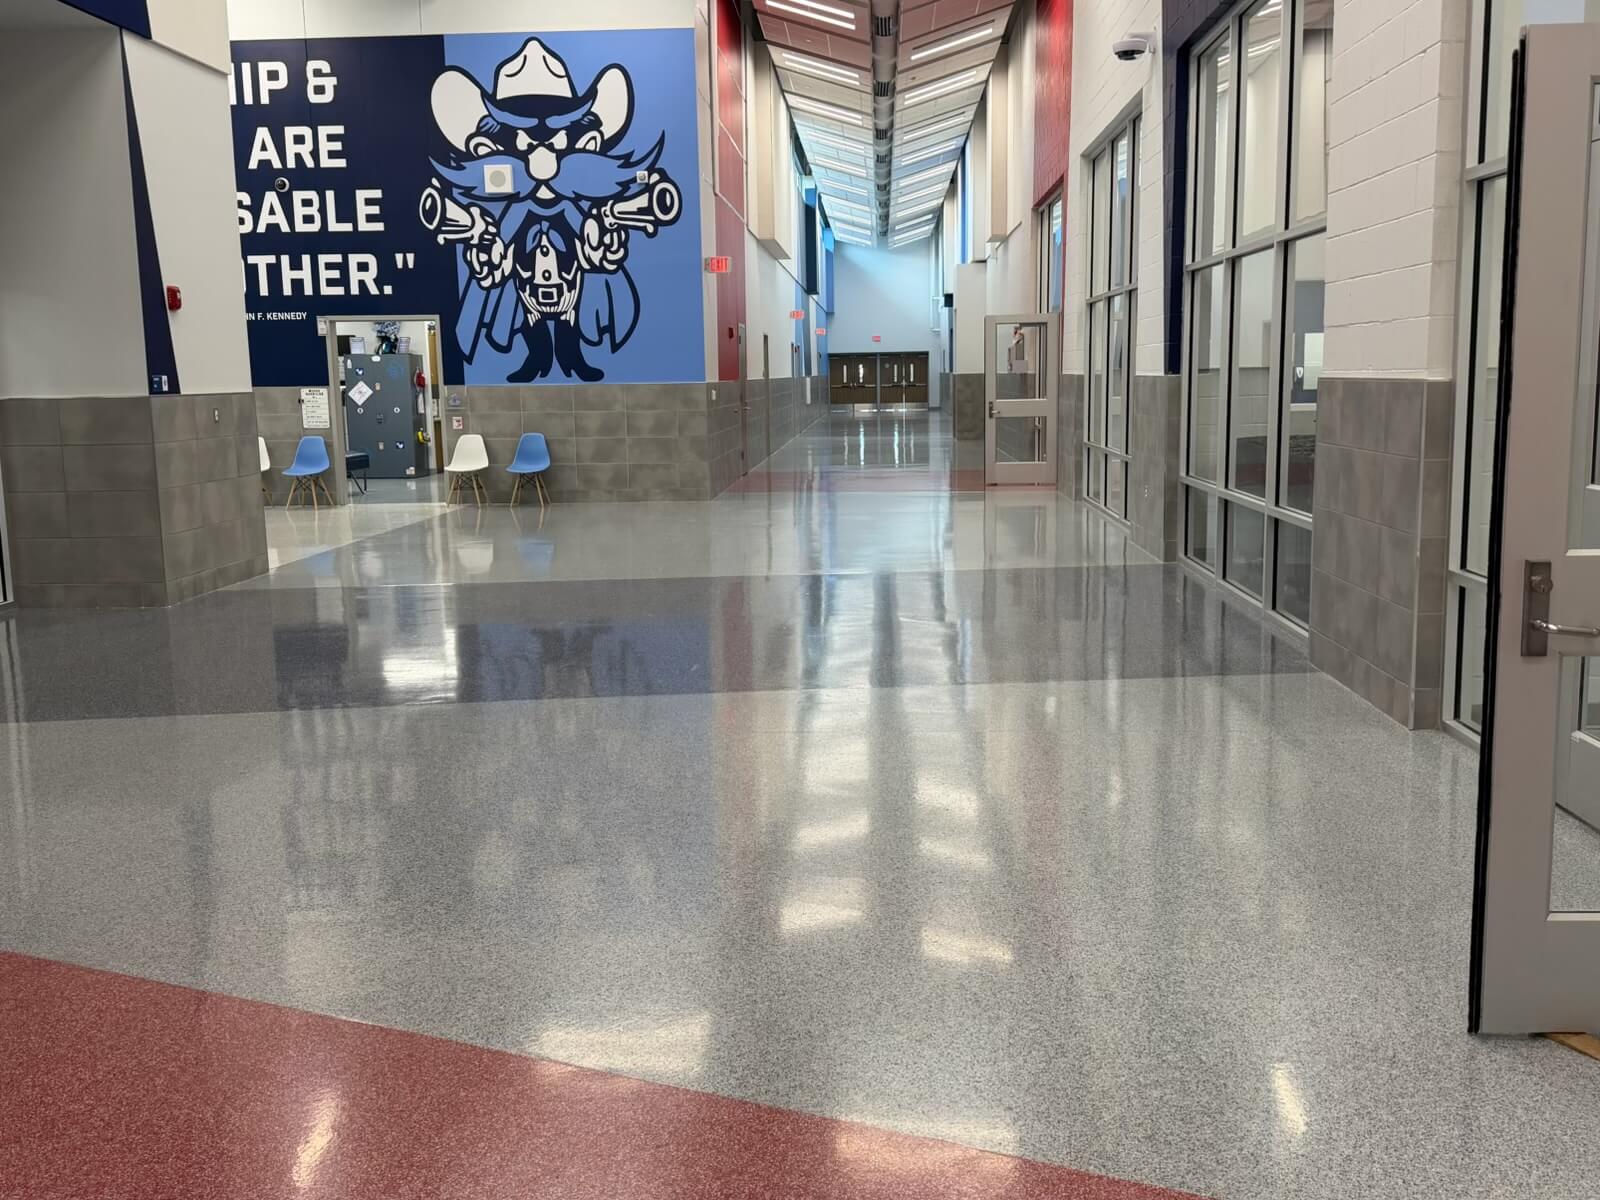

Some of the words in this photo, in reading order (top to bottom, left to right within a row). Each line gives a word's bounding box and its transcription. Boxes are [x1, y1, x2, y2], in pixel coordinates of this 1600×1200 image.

[306, 60, 337, 104] &
[248, 125, 347, 169] ARE
[242, 253, 415, 296] THER."
[710, 257, 729, 272] EXIT
[257, 312, 265, 320] F.
[266, 311, 307, 320] KENNEDY
